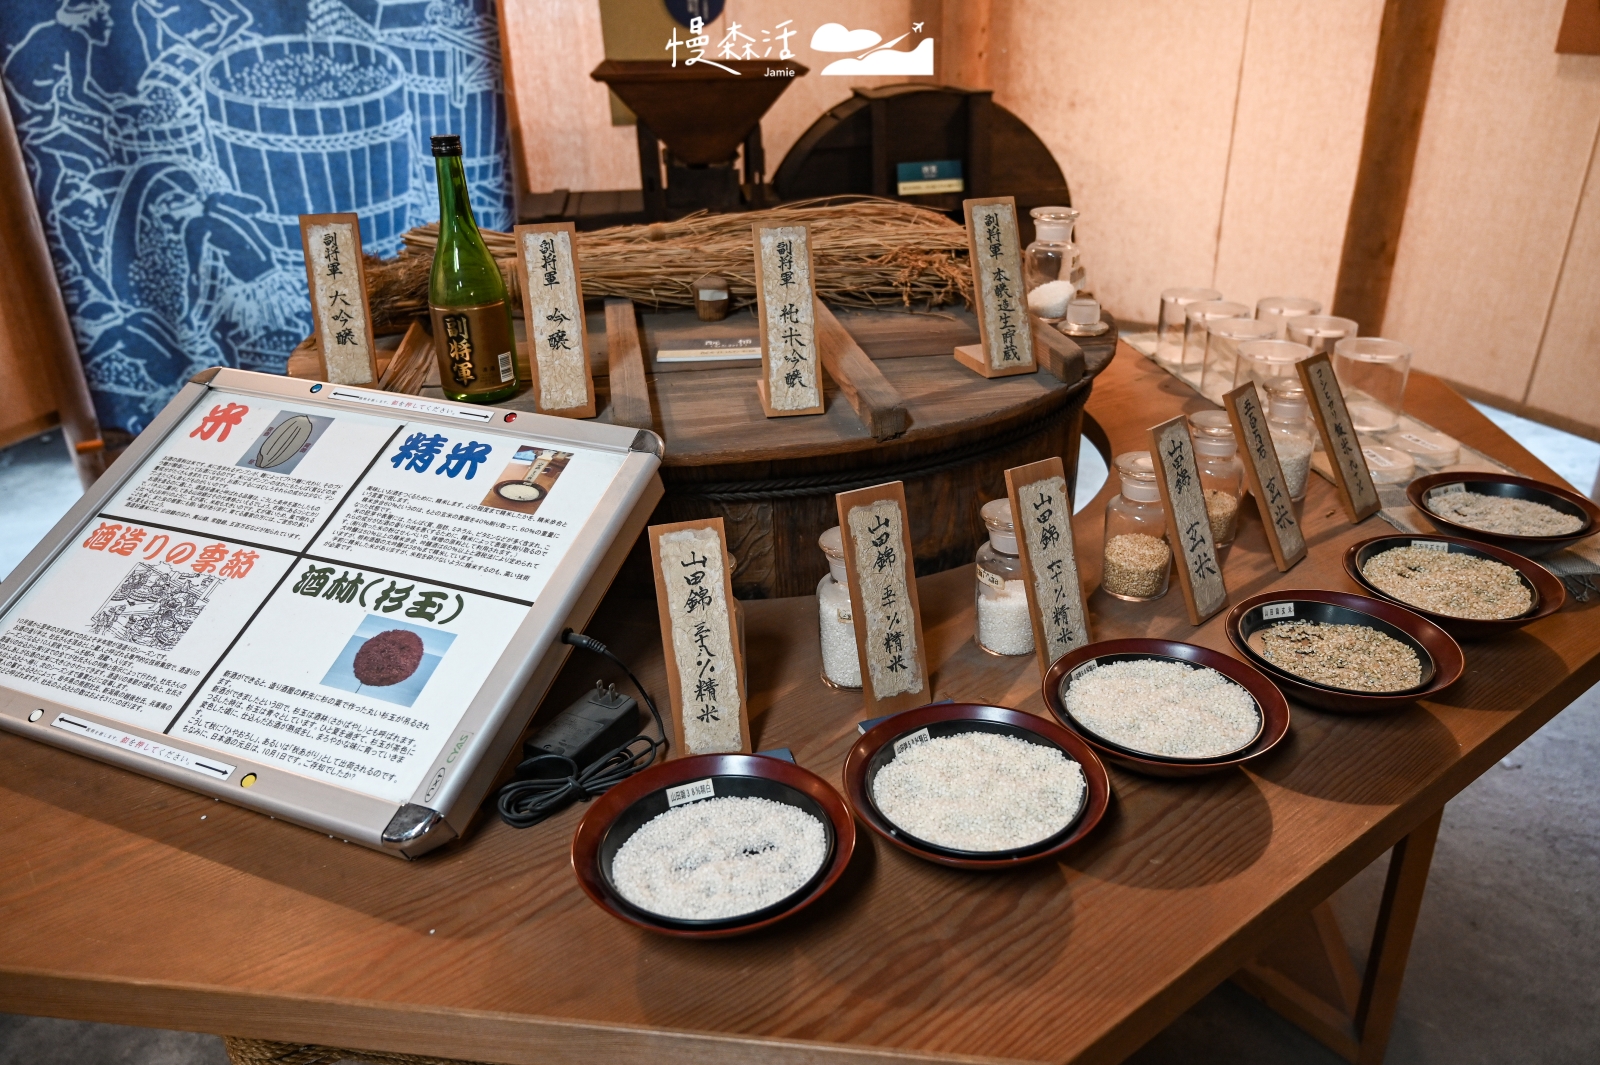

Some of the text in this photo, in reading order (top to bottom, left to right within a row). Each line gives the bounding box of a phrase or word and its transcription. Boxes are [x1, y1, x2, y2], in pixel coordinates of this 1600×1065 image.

[323, 232, 343, 279] 副将軍
[984, 212, 1004, 260] 副将軍
[539, 239, 560, 290] 副将軍
[777, 240, 797, 288] 副将軍
[444, 316, 476, 386] 副将軍
[190, 403, 249, 442] 米
[390, 431, 492, 480] 精米
[1033, 492, 1060, 550] 山田錦
[1168, 439, 1217, 579] 山田錦 玄米
[1265, 476, 1295, 529] 玄米
[83, 523, 259, 578] 酒造りの季節
[868, 515, 896, 572] 山田錦
[292, 564, 464, 625] 酒林(杉玉)
[681, 551, 713, 613] 山田錦
[445, 733, 470, 765] CYAS
